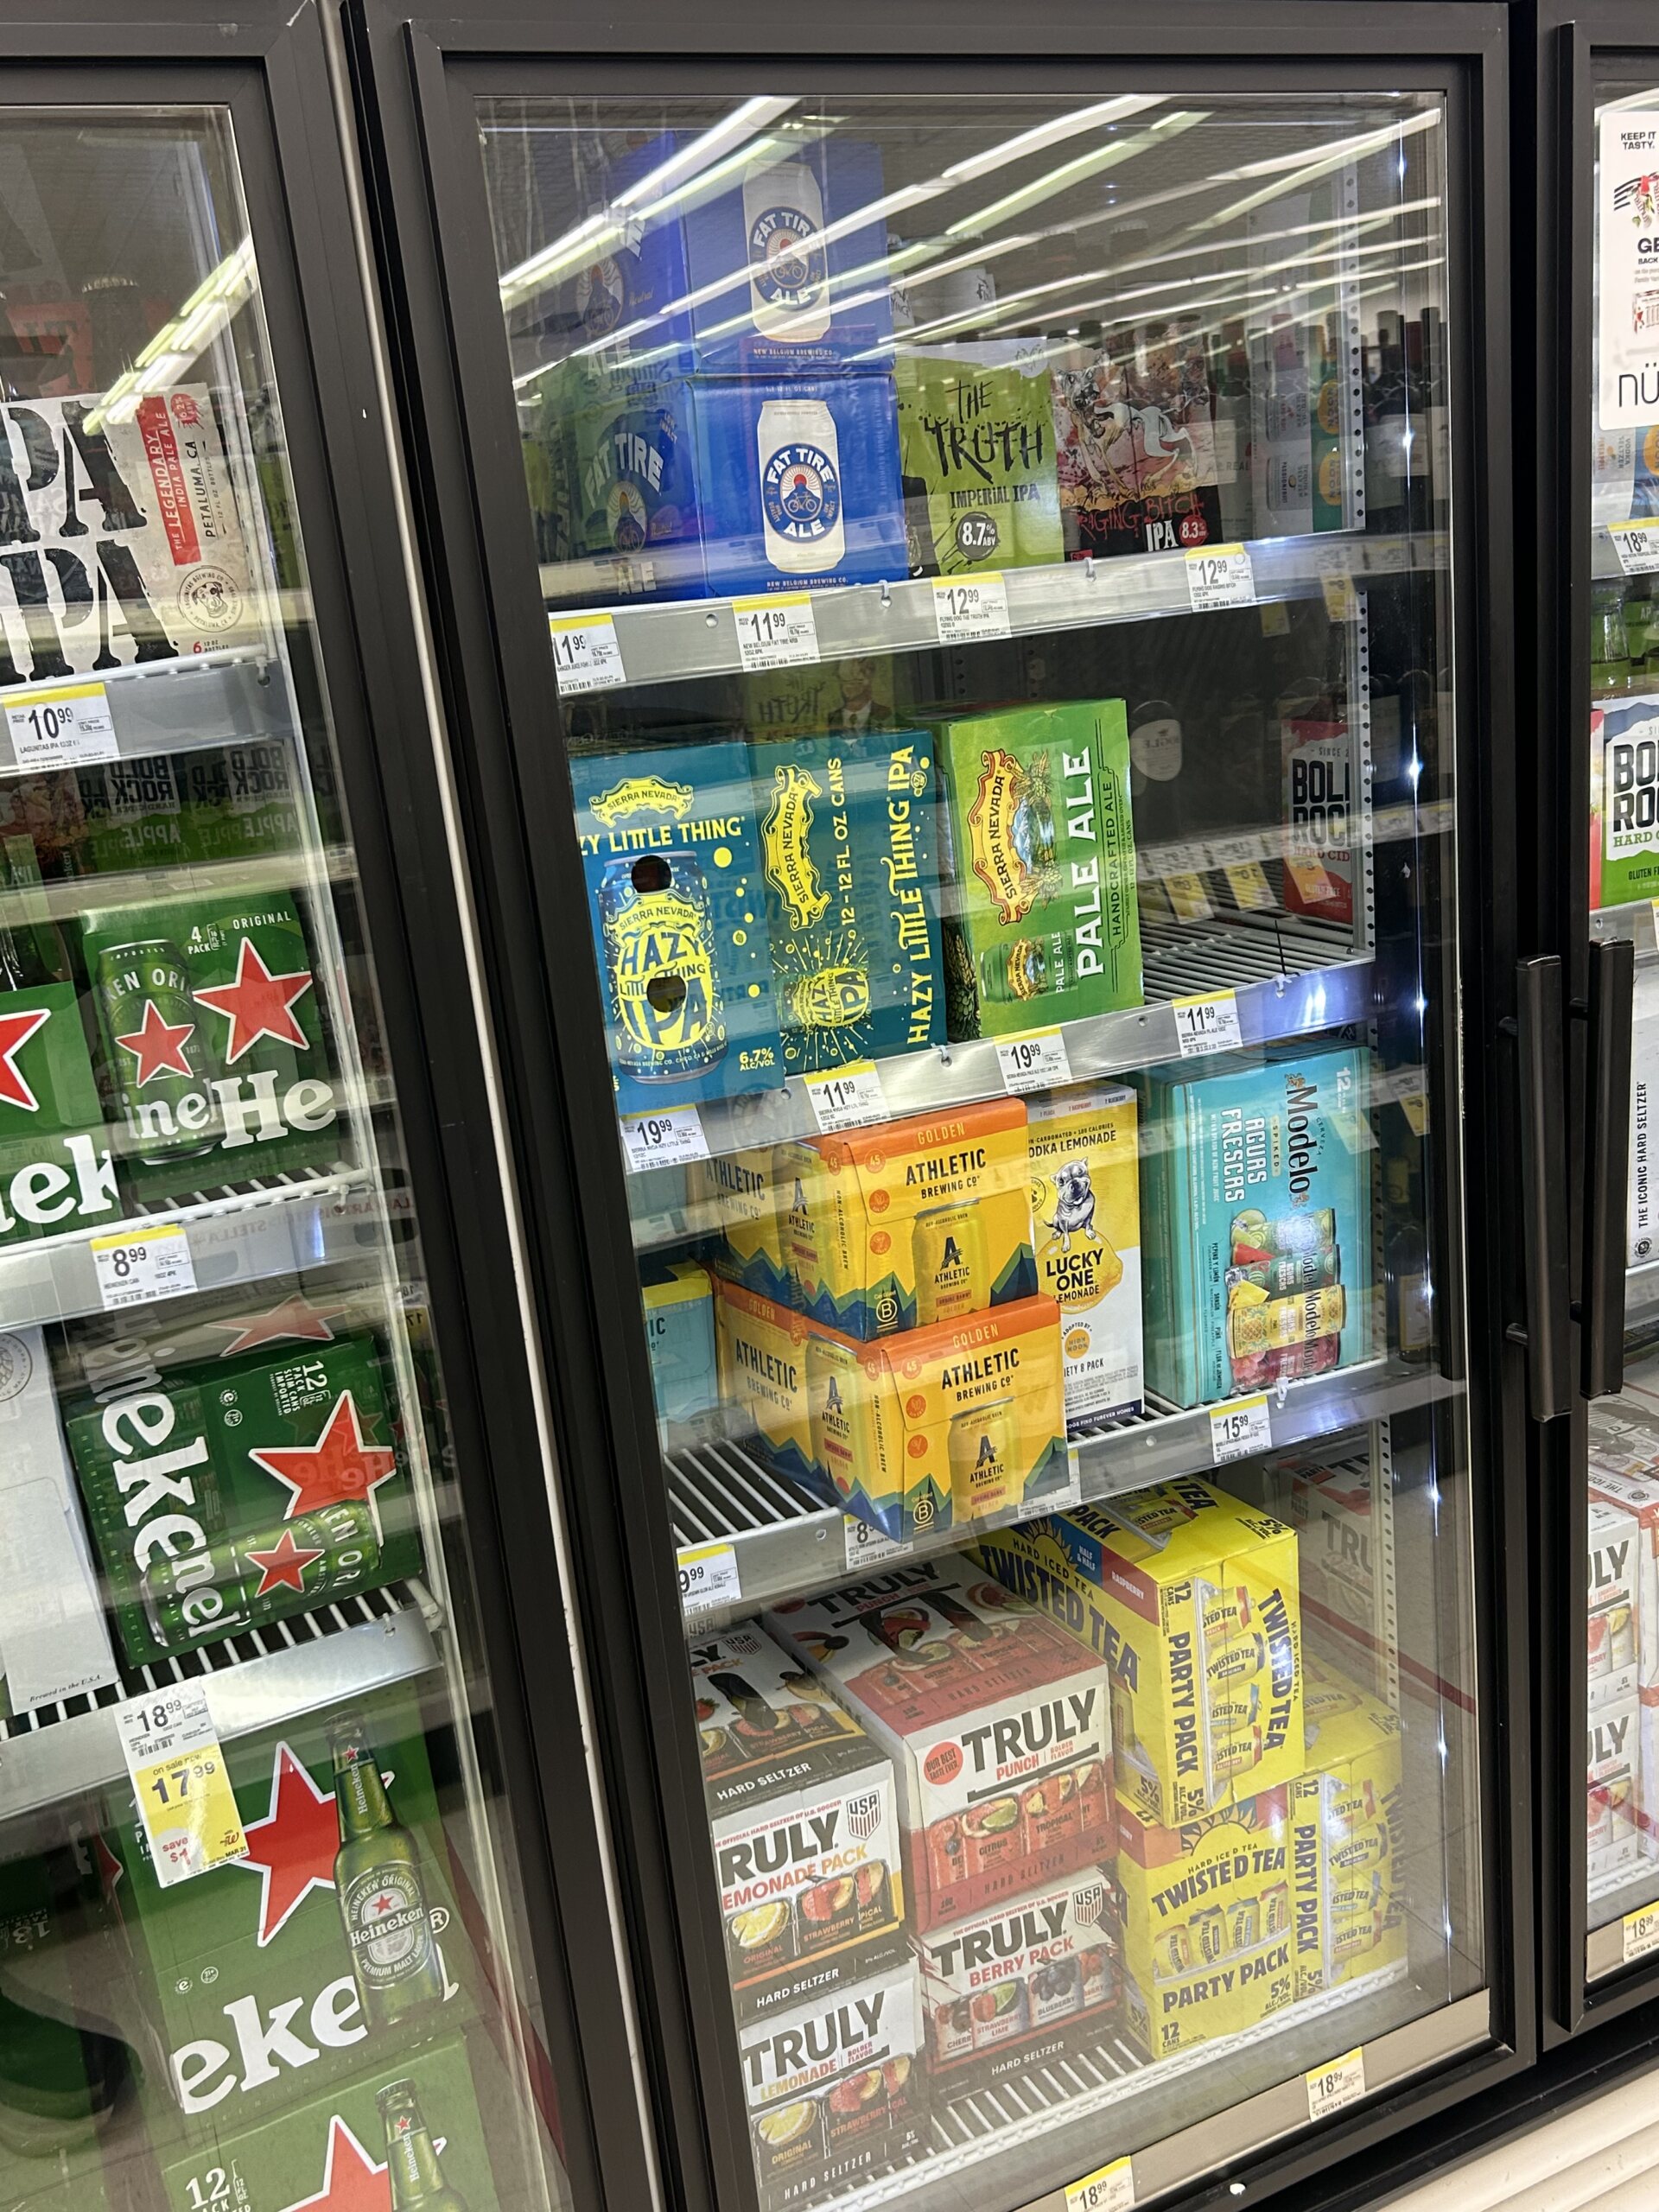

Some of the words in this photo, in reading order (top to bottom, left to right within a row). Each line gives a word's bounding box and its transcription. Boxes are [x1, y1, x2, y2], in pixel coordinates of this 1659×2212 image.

[1621, 131, 1645, 141] KEEP
[1648, 130, 1656, 140] IT
[946, 379, 994, 423] THE
[156, 411, 172, 435] ALE
[166, 440, 180, 473] PALE
[186, 440, 198, 459] CA
[766, 448, 791, 484] FAT
[796, 448, 834, 483] TIRE
[925, 416, 1043, 484] TRUTH
[148, 433, 179, 528] LEGENDARY
[172, 475, 188, 508] INDIA
[1013, 483, 1041, 502] IPA
[784, 518, 825, 538] ALE
[1077, 503, 1141, 541] RAGING
[1145, 496, 1204, 520] BITCH
[171, 529, 181, 551] THE
[887, 746, 913, 792] IPA
[988, 776, 1004, 842] NEVADA
[1063, 747, 1097, 842] ALE
[1104, 781, 1115, 810] ALE
[608, 825, 673, 853] LITTLE
[677, 817, 743, 843] THING
[782, 790, 798, 849] NEVADA
[880, 797, 918, 897] THING
[1613, 831, 1653, 848] HARD
[789, 854, 810, 905] SIERRA
[992, 849, 1017, 899] SIERRA
[1105, 817, 1121, 936] HANDCRAFTED
[1629, 868, 1652, 880] GLUTEN
[191, 926, 202, 943] 4
[232, 911, 291, 930] ORIGINAL
[620, 908, 654, 931] SIERRA
[656, 906, 696, 919] NEVADA
[892, 887, 931, 962] LITTLE
[1071, 856, 1104, 980] PALE
[188, 943, 210, 954] PACK
[620, 931, 701, 976] HAZY
[1052, 931, 1062, 956] ALE
[1055, 962, 1065, 995] PALE
[907, 971, 933, 1045] HAZY
[739, 1047, 774, 1064] 6.7%
[740, 1060, 776, 1071] ALC/VOL
[211, 1070, 338, 1149] He
[1636, 1082, 1647, 1131] SELTZER
[918, 1122, 966, 1145] GOLDEN
[1060, 1130, 1116, 1153] LEMONADE
[1244, 1117, 1268, 1185] AGUAS
[1287, 1084, 1319, 1194] Modelo
[1316, 1116, 1327, 1156] CERVEZA
[1637, 1133, 1647, 1164] HARD
[906, 1148, 987, 1186] ATHLETIC
[1220, 1107, 1245, 1203] FRESCAS
[1637, 1166, 1649, 1205] ICONIC
[1638, 1207, 1649, 1229] THE
[1046, 1248, 1104, 1278] LUCKY
[1057, 1270, 1094, 1291] ONE
[748, 1299, 775, 1320] GOLDEN
[1305, 1293, 1321, 1337] Modelo
[952, 1324, 999, 1349] GOLDEN
[1062, 1322, 1081, 1337] ADOPTED
[292, 1367, 306, 1391] PACK
[302, 1360, 327, 1391] 12
[736, 1338, 798, 1394] ATHLETIC
[942, 1348, 1020, 1389] ATHLETIC
[275, 1372, 292, 1414] IMPORTED
[747, 1376, 779, 1405] BREWING
[957, 1382, 998, 1402] BREWING
[1013, 1538, 1040, 1560] HARD
[1045, 1556, 1070, 1580] ICED
[1074, 1579, 1094, 1602] TEA
[1112, 1572, 1144, 1599] RASPBERRY
[979, 1544, 1084, 1633] TWISTED
[1089, 1605, 1138, 1694] TEA
[1258, 1587, 1293, 1700] TWISTED
[1168, 1631, 1195, 1709] PARTY
[29, 1688, 58, 1702] Brewed
[68, 1681, 80, 1692] the
[961, 1688, 1096, 1772] TRULY
[1263, 1700, 1292, 1751] TEA
[926, 1758, 939, 1772] OUR
[939, 1748, 957, 1765] BEST
[1173, 1713, 1199, 1777] PACK
[152, 1766, 164, 1776] on
[166, 1760, 183, 1771] sale
[716, 1778, 755, 1799] HARD
[759, 1762, 812, 1787] SELTZER
[929, 1769, 946, 1782] TASTE
[996, 1752, 1039, 1780] PUNCH
[355, 1764, 369, 1814] Heineken
[849, 1793, 878, 1815] USA
[722, 1832, 750, 1847] OFFICIAL
[751, 1823, 769, 1837] HARD
[769, 1815, 795, 1830] SELTZER
[817, 1800, 842, 1814] SOCCER
[162, 1837, 188, 1852] save
[170, 1847, 191, 1866] $1
[226, 1849, 239, 1858] MAR
[821, 1843, 868, 1875] PACK
[979, 1840, 1007, 1856] CITRUS
[1294, 1823, 1318, 1893] PARTY
[1076, 1885, 1102, 1906] USA
[1151, 1855, 1249, 1917] TWISTED
[1252, 1847, 1286, 1873] TEA
[349, 1907, 423, 1947] Heineken
[931, 1899, 1068, 1978] TRULY
[1296, 1897, 1319, 1955] PACK
[969, 1954, 1025, 1988] BERRY
[1029, 1935, 1075, 1965] PACK
[1163, 1970, 1235, 2013] PARTY
[1241, 1943, 1289, 1986] PACK
[756, 1987, 791, 2008] HARD
[792, 1967, 840, 1993] SELTZER
[1271, 1974, 1291, 1999] 5%
[976, 2013, 1021, 2034] STRAWBERRY
[1037, 1996, 1075, 2016] BLUEBERRY
[741, 1991, 885, 2088] TRULY
[991, 2024, 1009, 2037] LIME
[1161, 2022, 1179, 2041] 12
[991, 2057, 1021, 2075] HARD
[1023, 2041, 1065, 2063] SELTZER
[760, 2059, 837, 2101] LEMONADE
[405, 2133, 420, 2183] Heineken
[186, 2167, 230, 2209] 12
